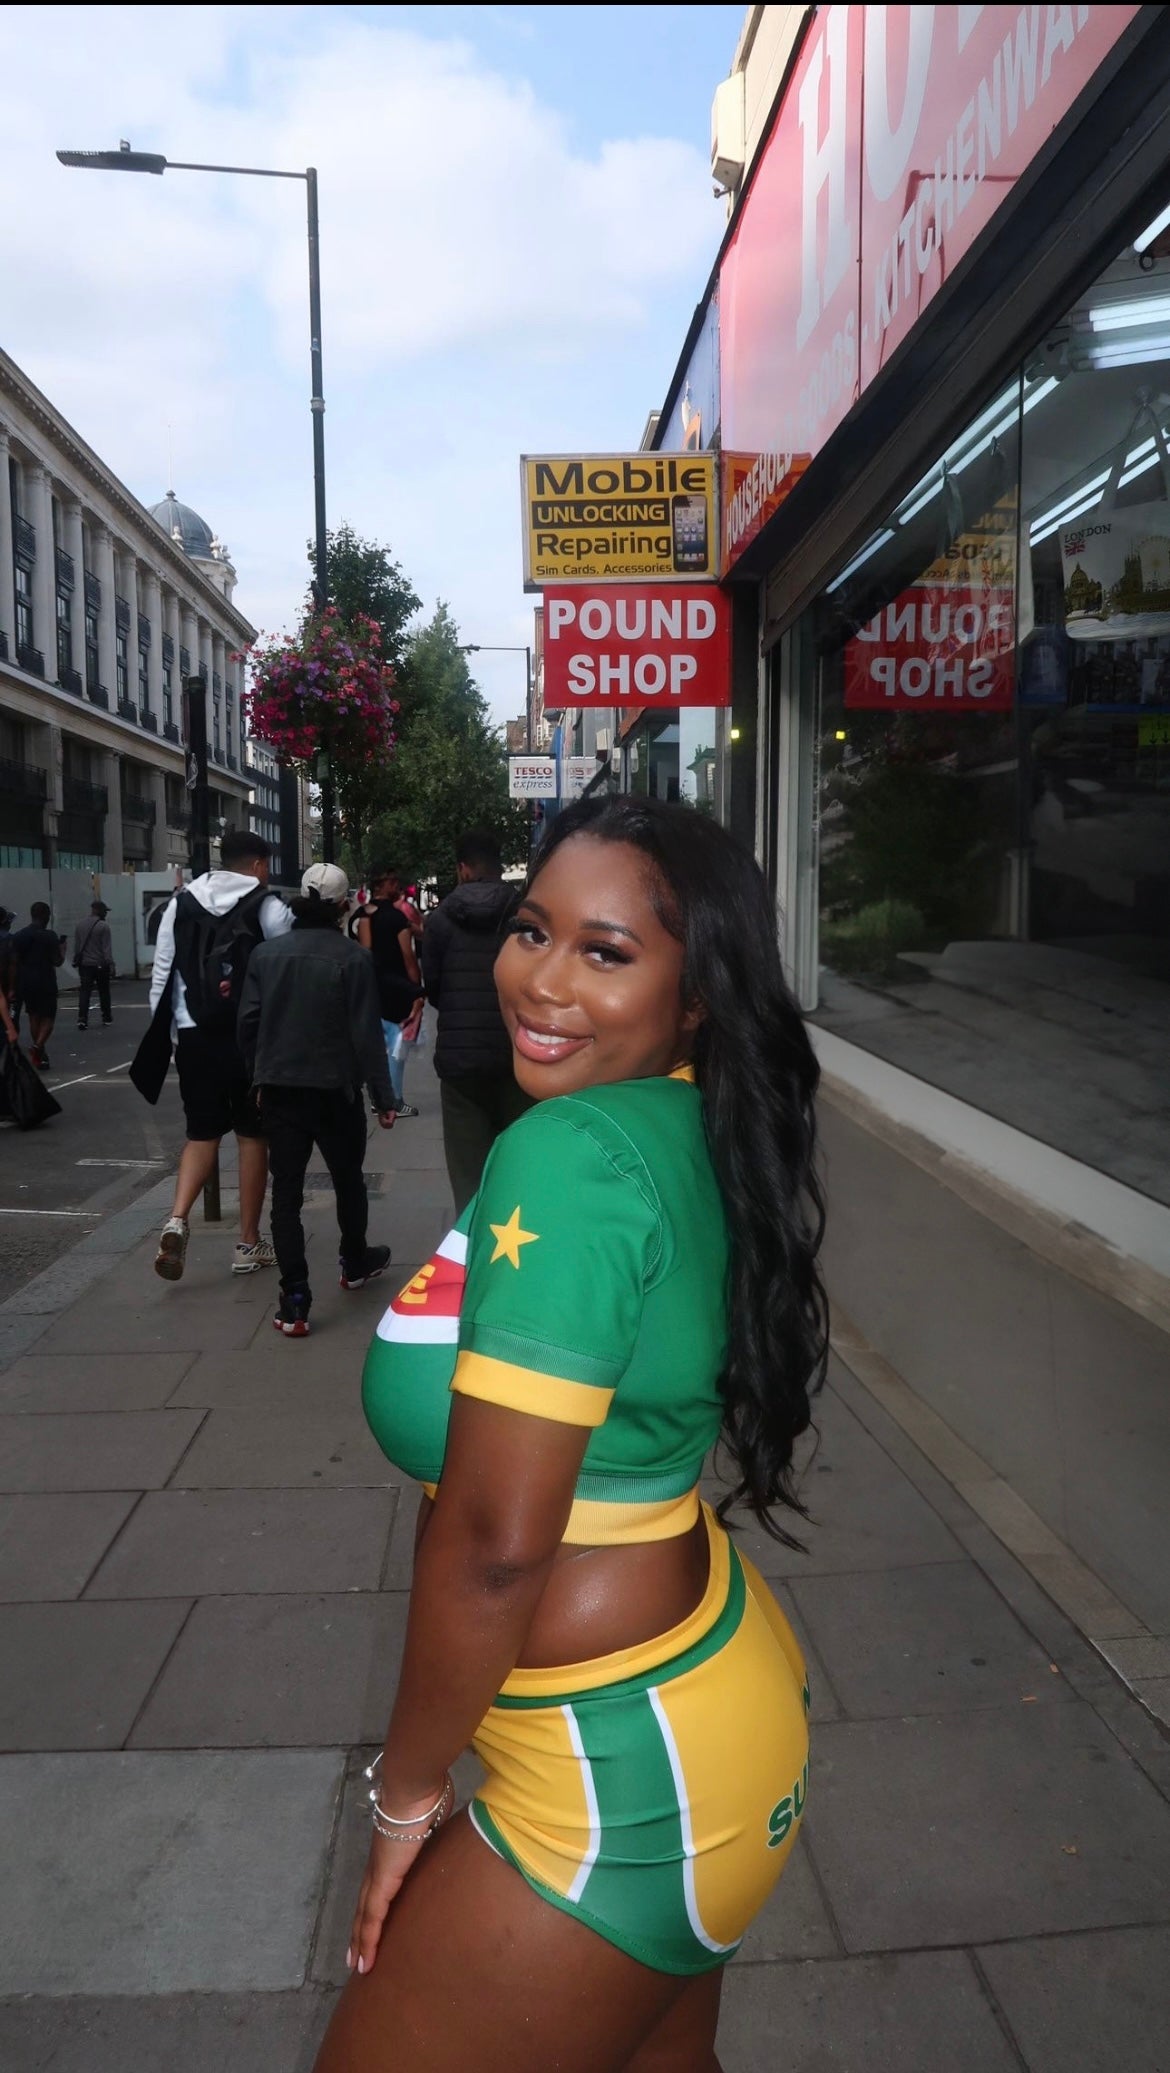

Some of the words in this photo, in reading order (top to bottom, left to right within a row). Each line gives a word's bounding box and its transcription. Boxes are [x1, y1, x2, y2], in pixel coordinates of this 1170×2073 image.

[797, 5, 985, 350] HO
[874, 5, 1089, 343] KITCHENWA
[535, 461, 706, 496] Mobile
[537, 504, 665, 524] UNLOCKING
[537, 532, 672, 560] Repairing
[1064, 523, 1112, 543] LONDON
[536, 565, 559, 576] Sim
[603, 562, 673, 575] Accessories
[549, 600, 716, 640] POUND
[567, 654, 697, 694] SHOP
[513, 780, 553, 791] express
[514, 767, 552, 776] TESCO
